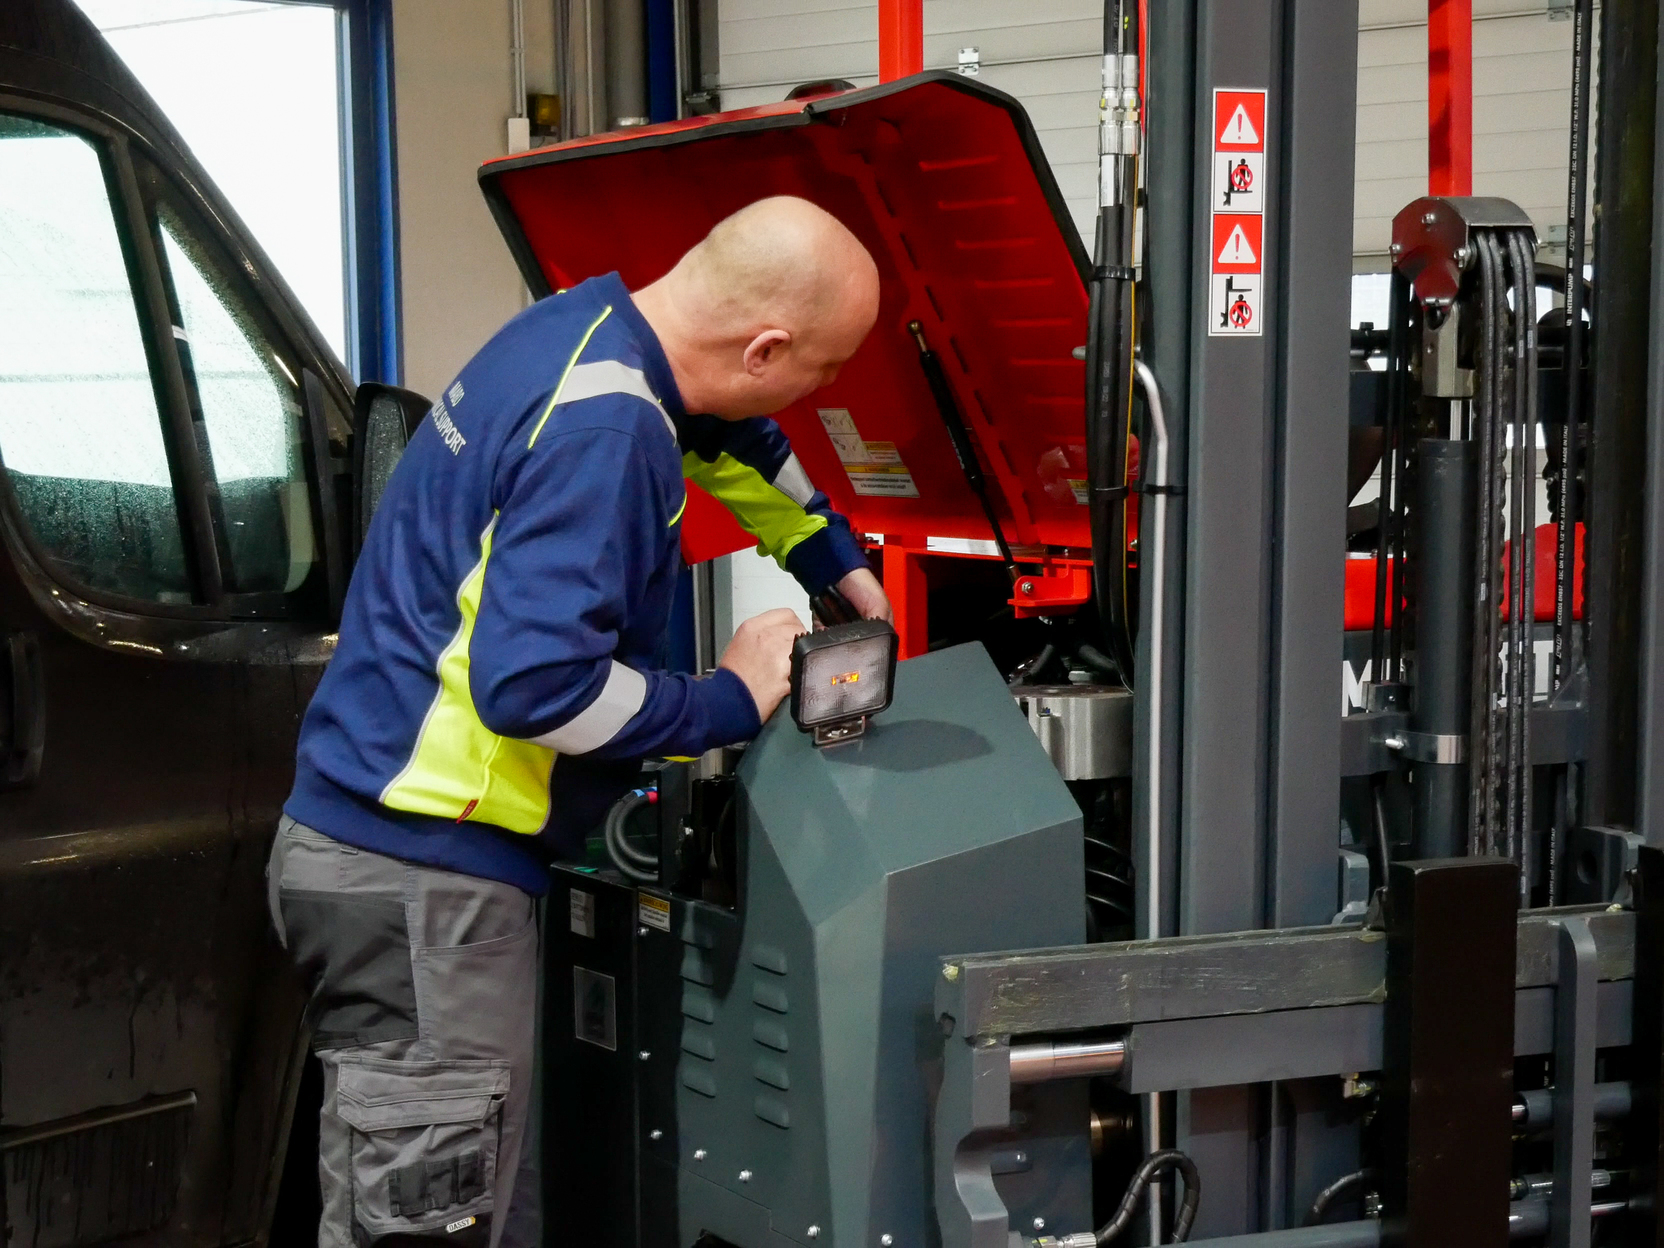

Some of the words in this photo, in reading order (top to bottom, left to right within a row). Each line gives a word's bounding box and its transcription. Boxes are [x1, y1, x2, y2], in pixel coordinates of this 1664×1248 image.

[1566, 273, 1574, 314] INTERPUMP
[435, 410, 467, 456] SUPPORT
[1559, 560, 1564, 568] DN
[449, 1218, 470, 1231] DASSY
